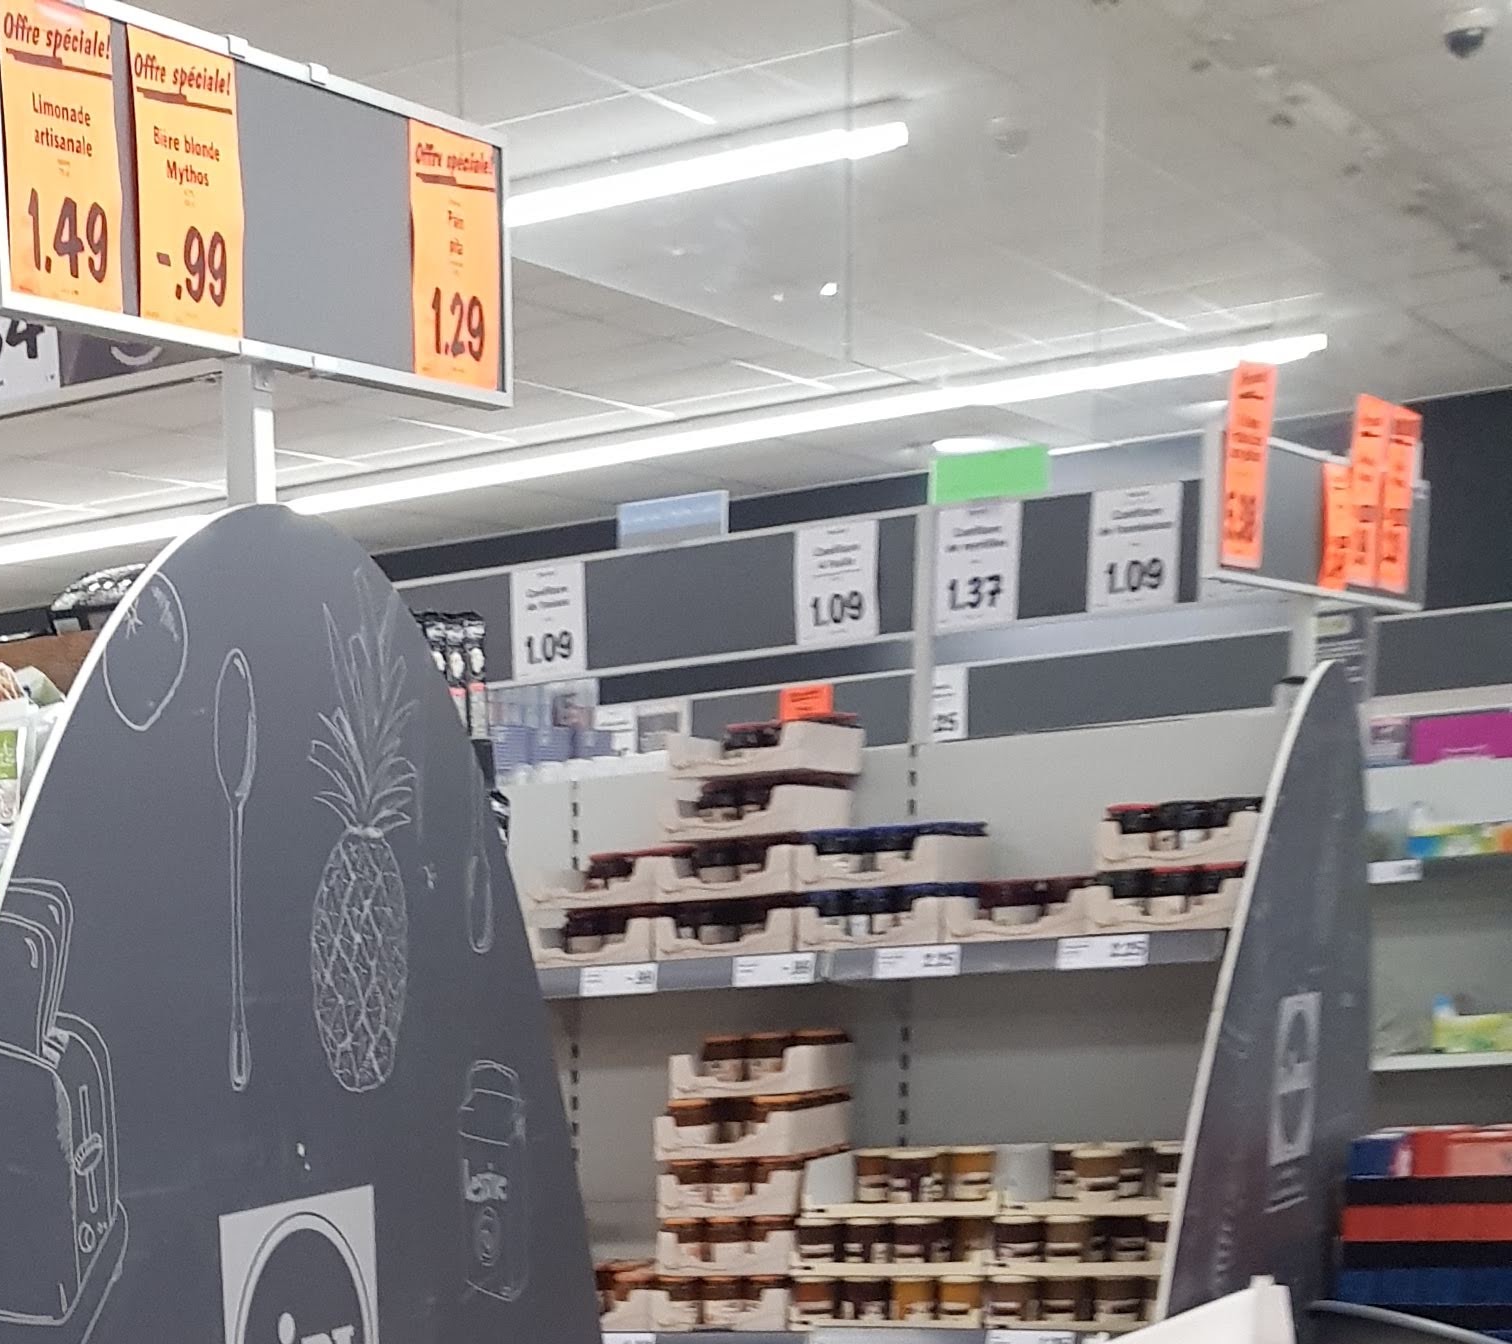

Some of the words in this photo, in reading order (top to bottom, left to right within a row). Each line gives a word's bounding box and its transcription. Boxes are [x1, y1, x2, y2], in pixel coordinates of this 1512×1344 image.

[3, 12, 41, 47] Offre
[45, 24, 112, 60] spéciale!
[134, 52, 167, 84] Offre
[171, 64, 232, 97] spéciale!
[31, 92, 92, 127] Limonade
[33, 129, 93, 159] artisanale
[152, 126, 181, 154] Bière
[183, 138, 221, 162] blonde
[166, 160, 210, 188] Mythos
[28, 188, 108, 284] 1.49
[155, 225, 228, 308] -.99
[431, 286, 486, 362] 1.29
[1106, 557, 1165, 595] 1.09
[811, 589, 864, 628] 1.09
[524, 630, 574, 665] 1.09
